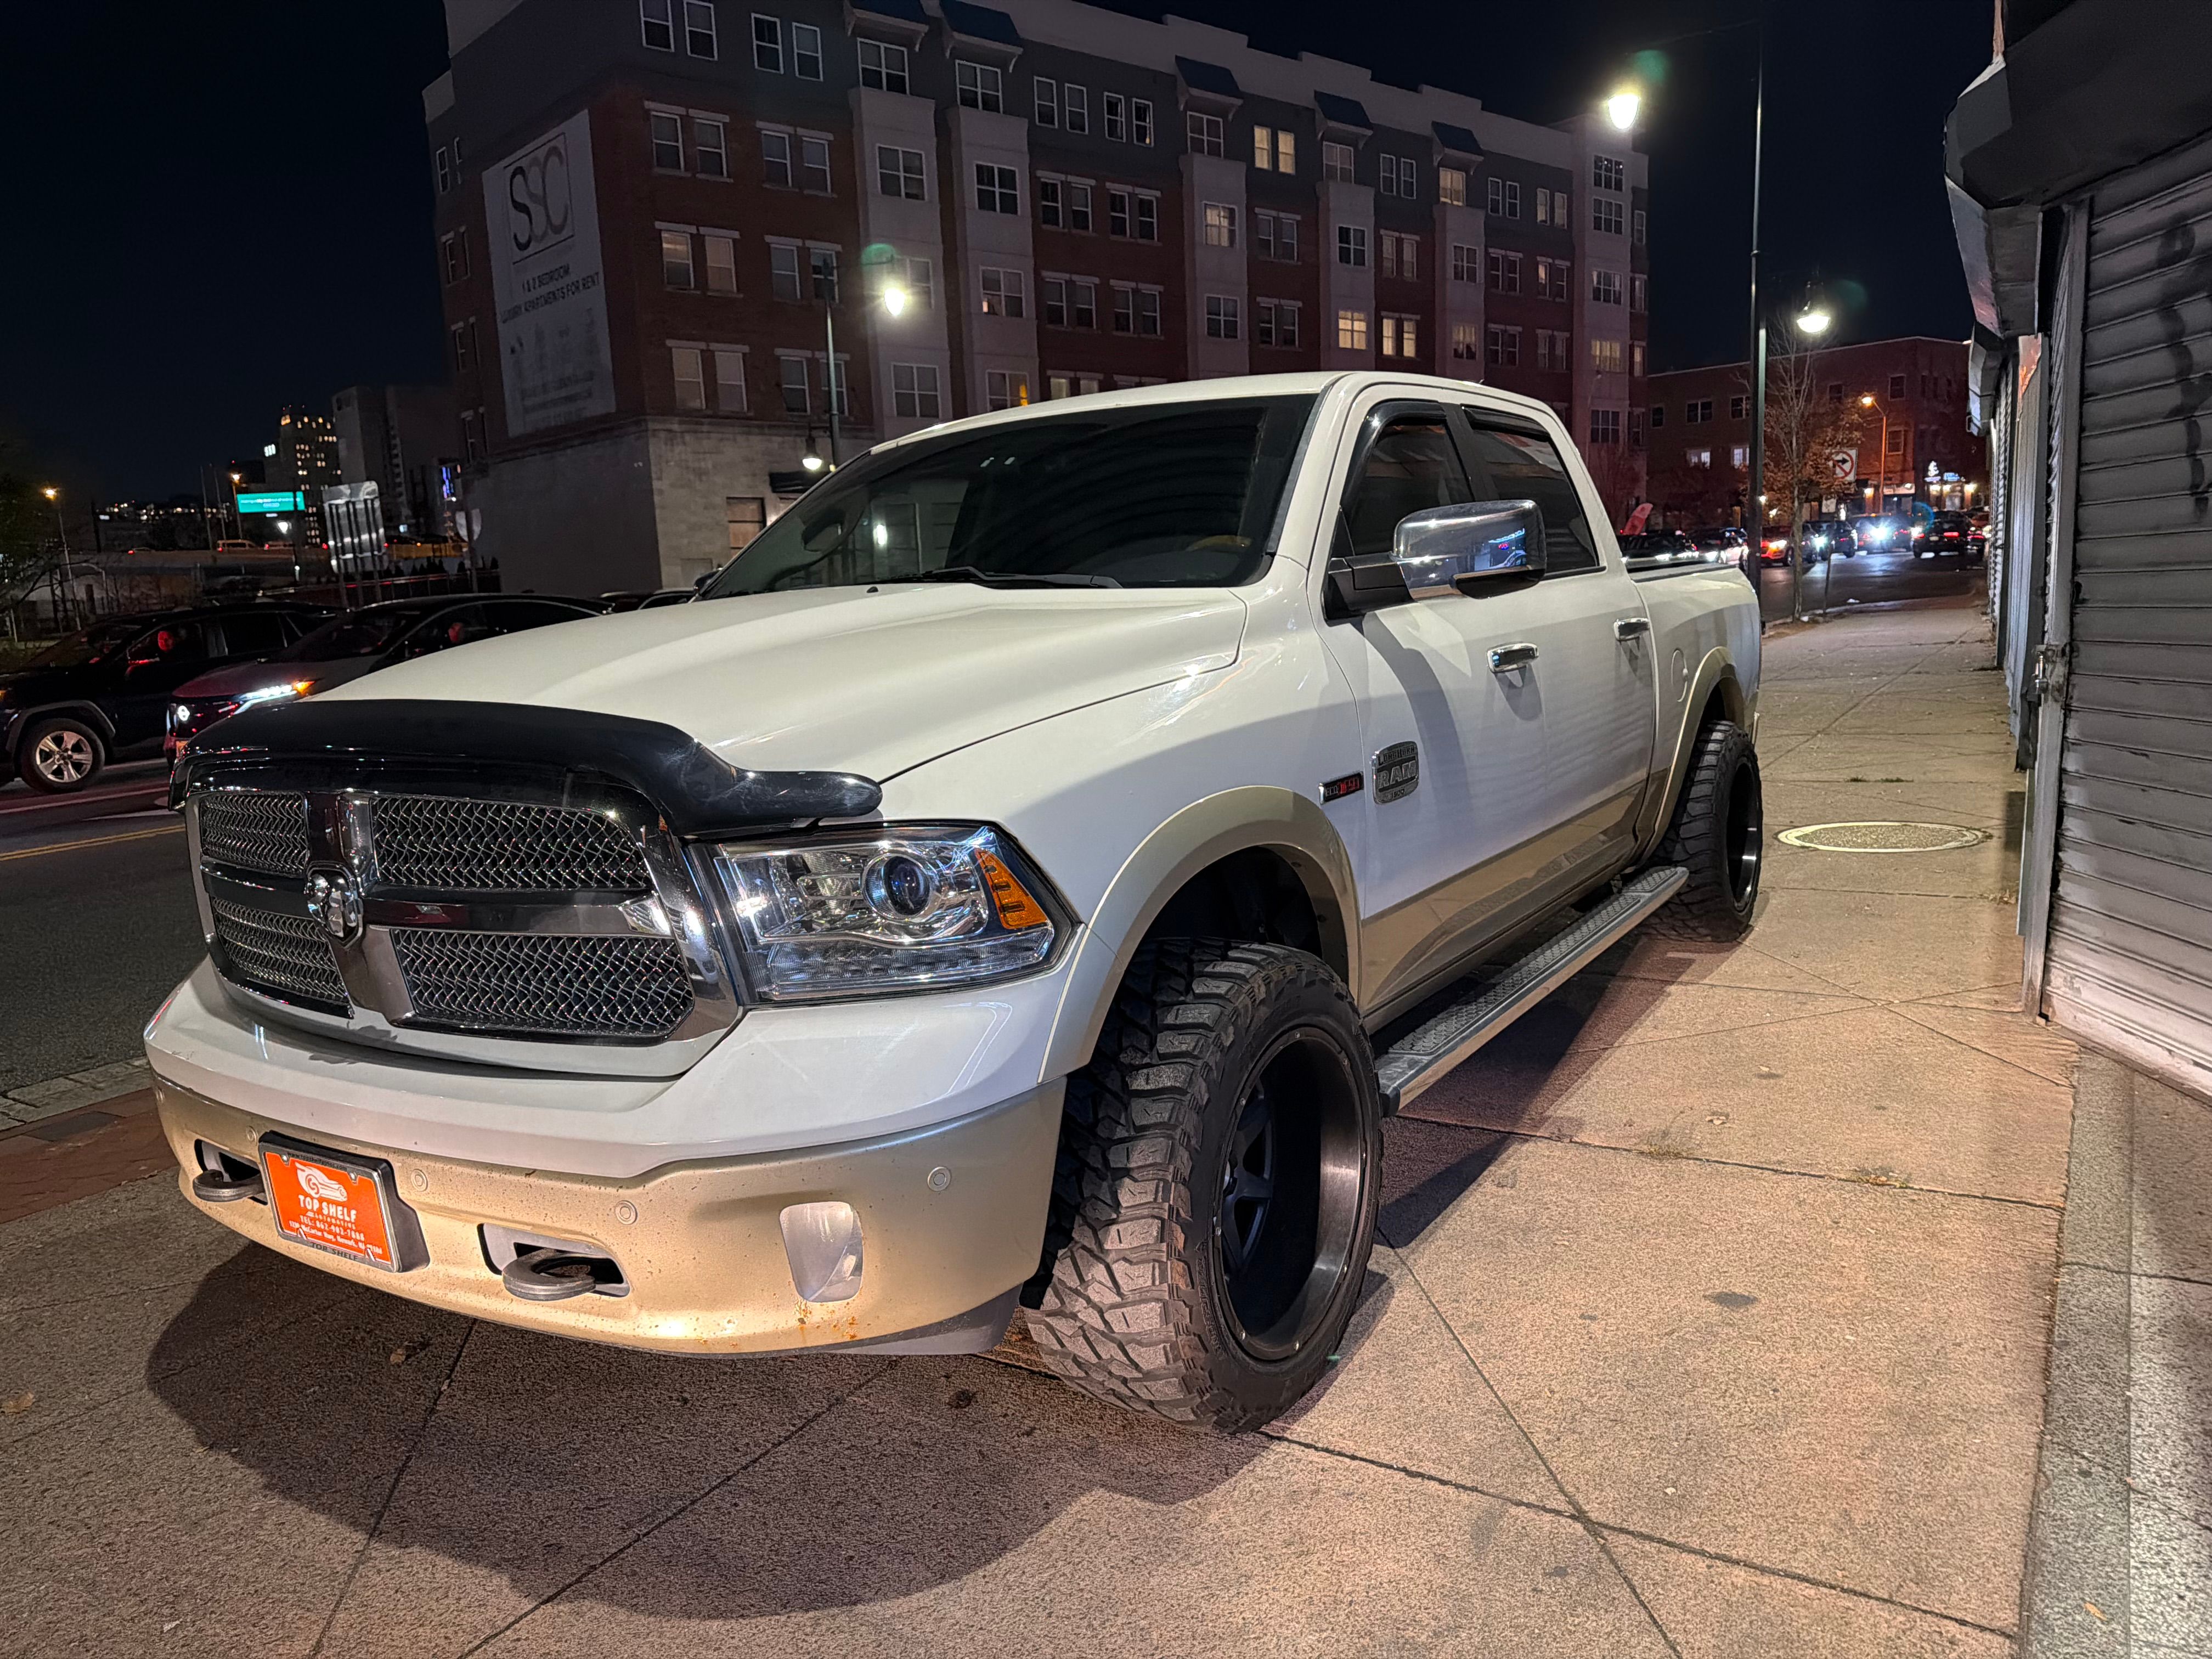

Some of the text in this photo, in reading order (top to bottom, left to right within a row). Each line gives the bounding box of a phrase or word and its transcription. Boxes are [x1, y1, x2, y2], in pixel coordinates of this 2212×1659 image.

[510, 146, 568, 251] SSC
[1377, 760, 1416, 788] RAM
[1391, 788, 1405, 799] 1500
[298, 1194, 357, 1223] TOP SHELF
[312, 1242, 358, 1261] TOP SHELF
